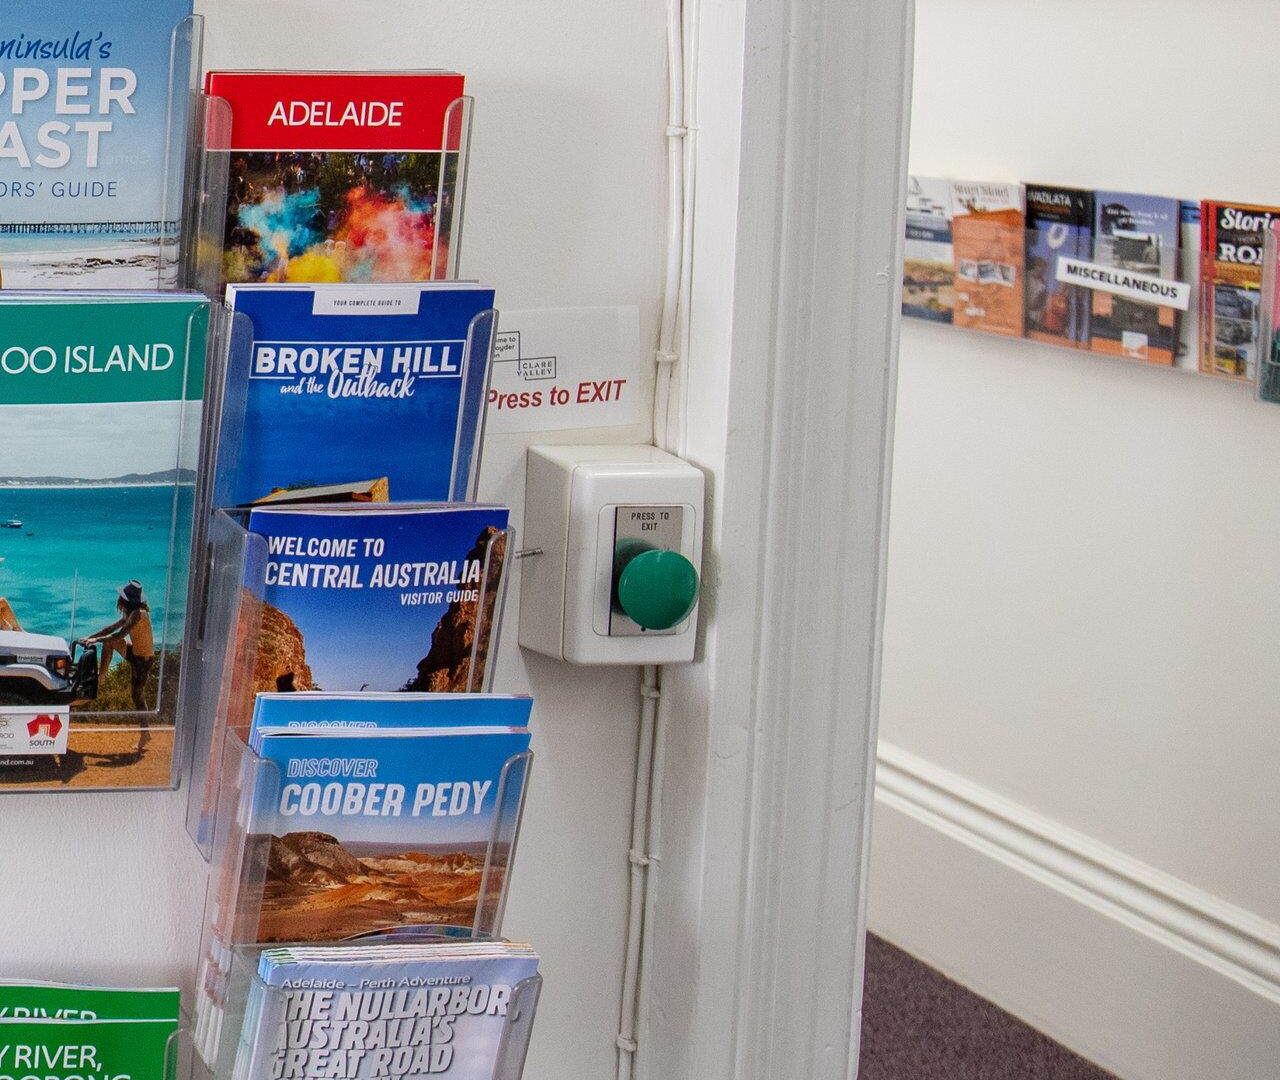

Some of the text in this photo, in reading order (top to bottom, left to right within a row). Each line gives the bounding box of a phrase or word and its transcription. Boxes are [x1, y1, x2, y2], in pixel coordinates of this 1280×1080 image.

[268, 101, 404, 126] ADELAIDE
[1067, 264, 1178, 299] MISCELLANEOUS
[64, 343, 174, 373] ISLAND
[255, 347, 457, 375] BROKEN HILL
[488, 380, 626, 409] Press to EXIT
[642, 523, 657, 531] EXIT
[268, 536, 385, 557] WELCOME TO
[264, 560, 481, 588] CENTRAL AUSTRALIA
[279, 780, 491, 817] COOBER PEDY
[15, 1044, 103, 1073] RIVER,
